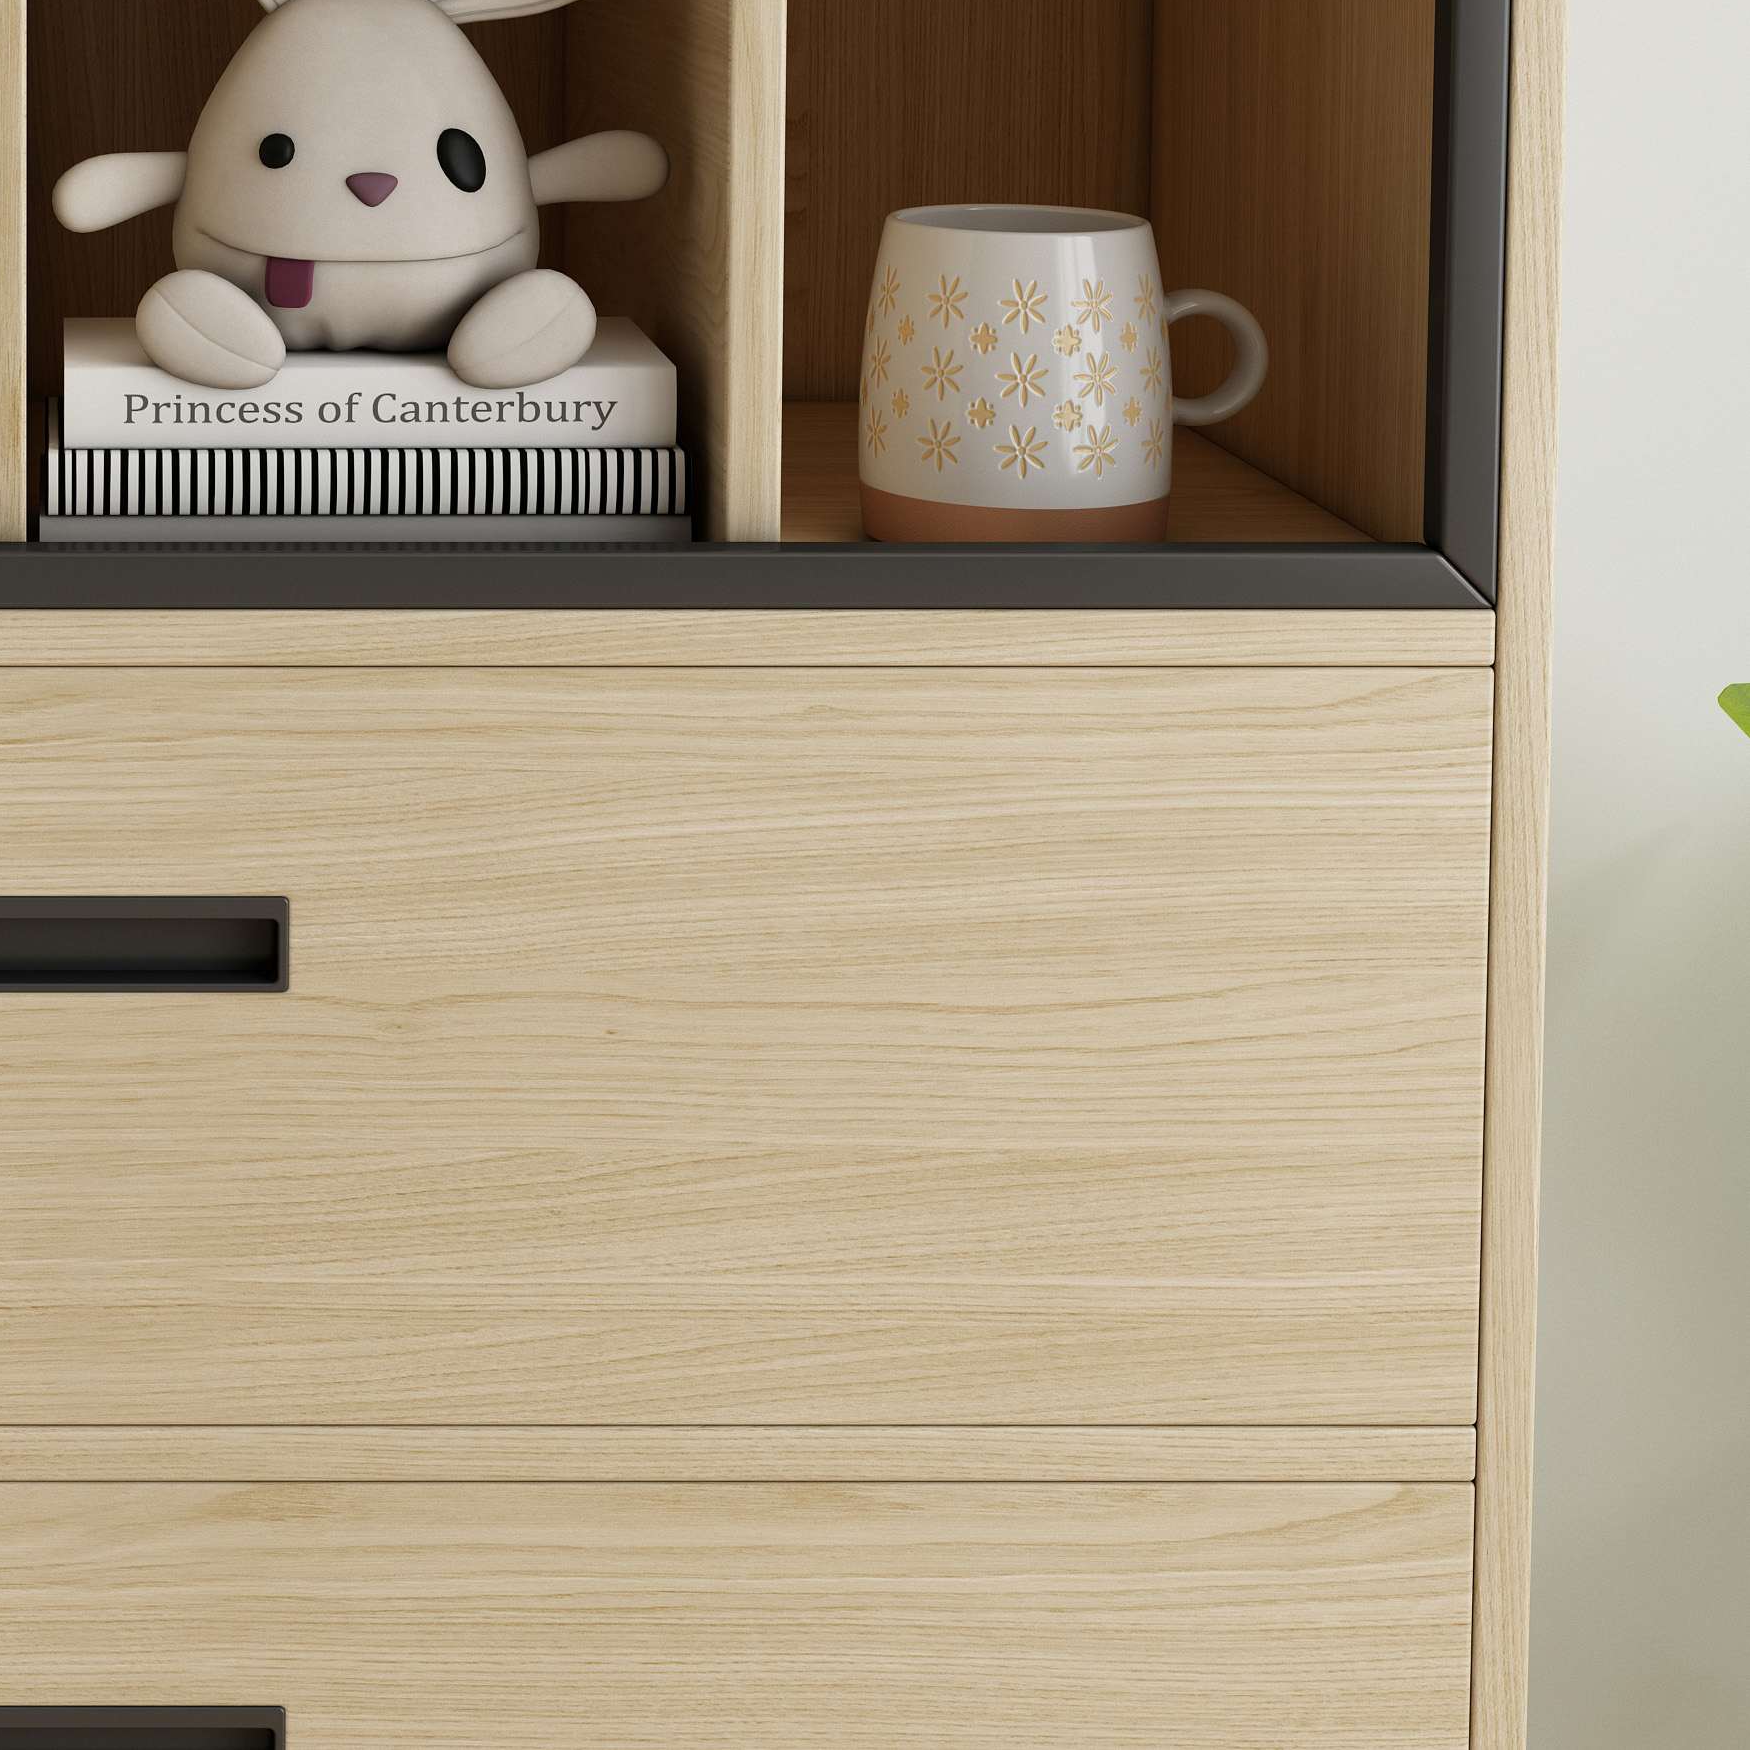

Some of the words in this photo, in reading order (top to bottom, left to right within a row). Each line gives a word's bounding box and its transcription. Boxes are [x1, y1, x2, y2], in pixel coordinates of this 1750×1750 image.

[123, 392, 304, 424] Princess
[317, 391, 363, 424] of
[371, 391, 619, 431] Canterbury
